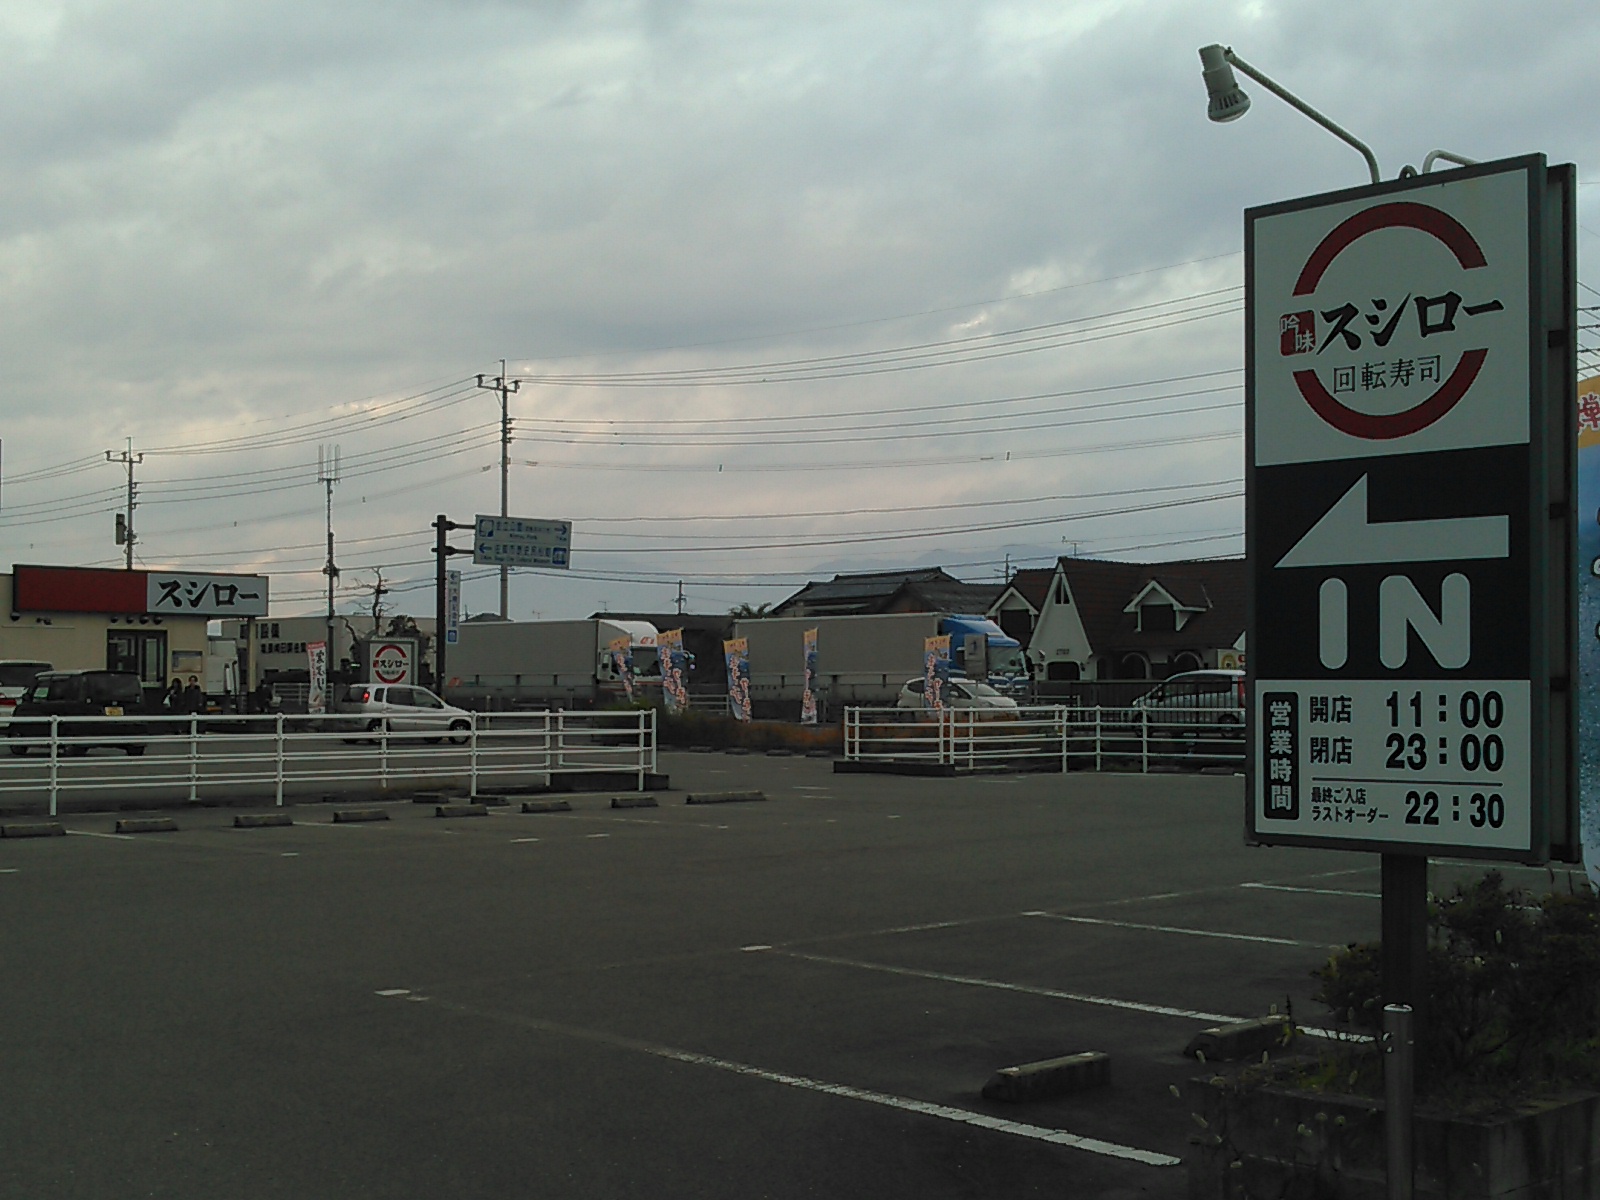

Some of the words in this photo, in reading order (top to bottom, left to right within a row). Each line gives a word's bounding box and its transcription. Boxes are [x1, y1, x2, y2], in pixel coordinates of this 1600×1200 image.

[1281, 315, 1315, 352] 吟味
[1316, 291, 1504, 355] スシロー
[1333, 355, 1441, 394] 回転寿司
[155, 579, 259, 608] スシロー
[1320, 573, 1470, 669] IN
[380, 659, 409, 668] スシロー
[1310, 695, 1352, 723] 開店
[1386, 690, 1504, 728] 11:00
[1269, 701, 1292, 810] 営業時間
[1310, 736, 1352, 764] 閉店
[1386, 733, 1504, 771] 23:00
[1311, 787, 1366, 805] 最終ご入店
[1311, 806, 1389, 823] ラストオーダー
[1405, 791, 1504, 828] 22:30
